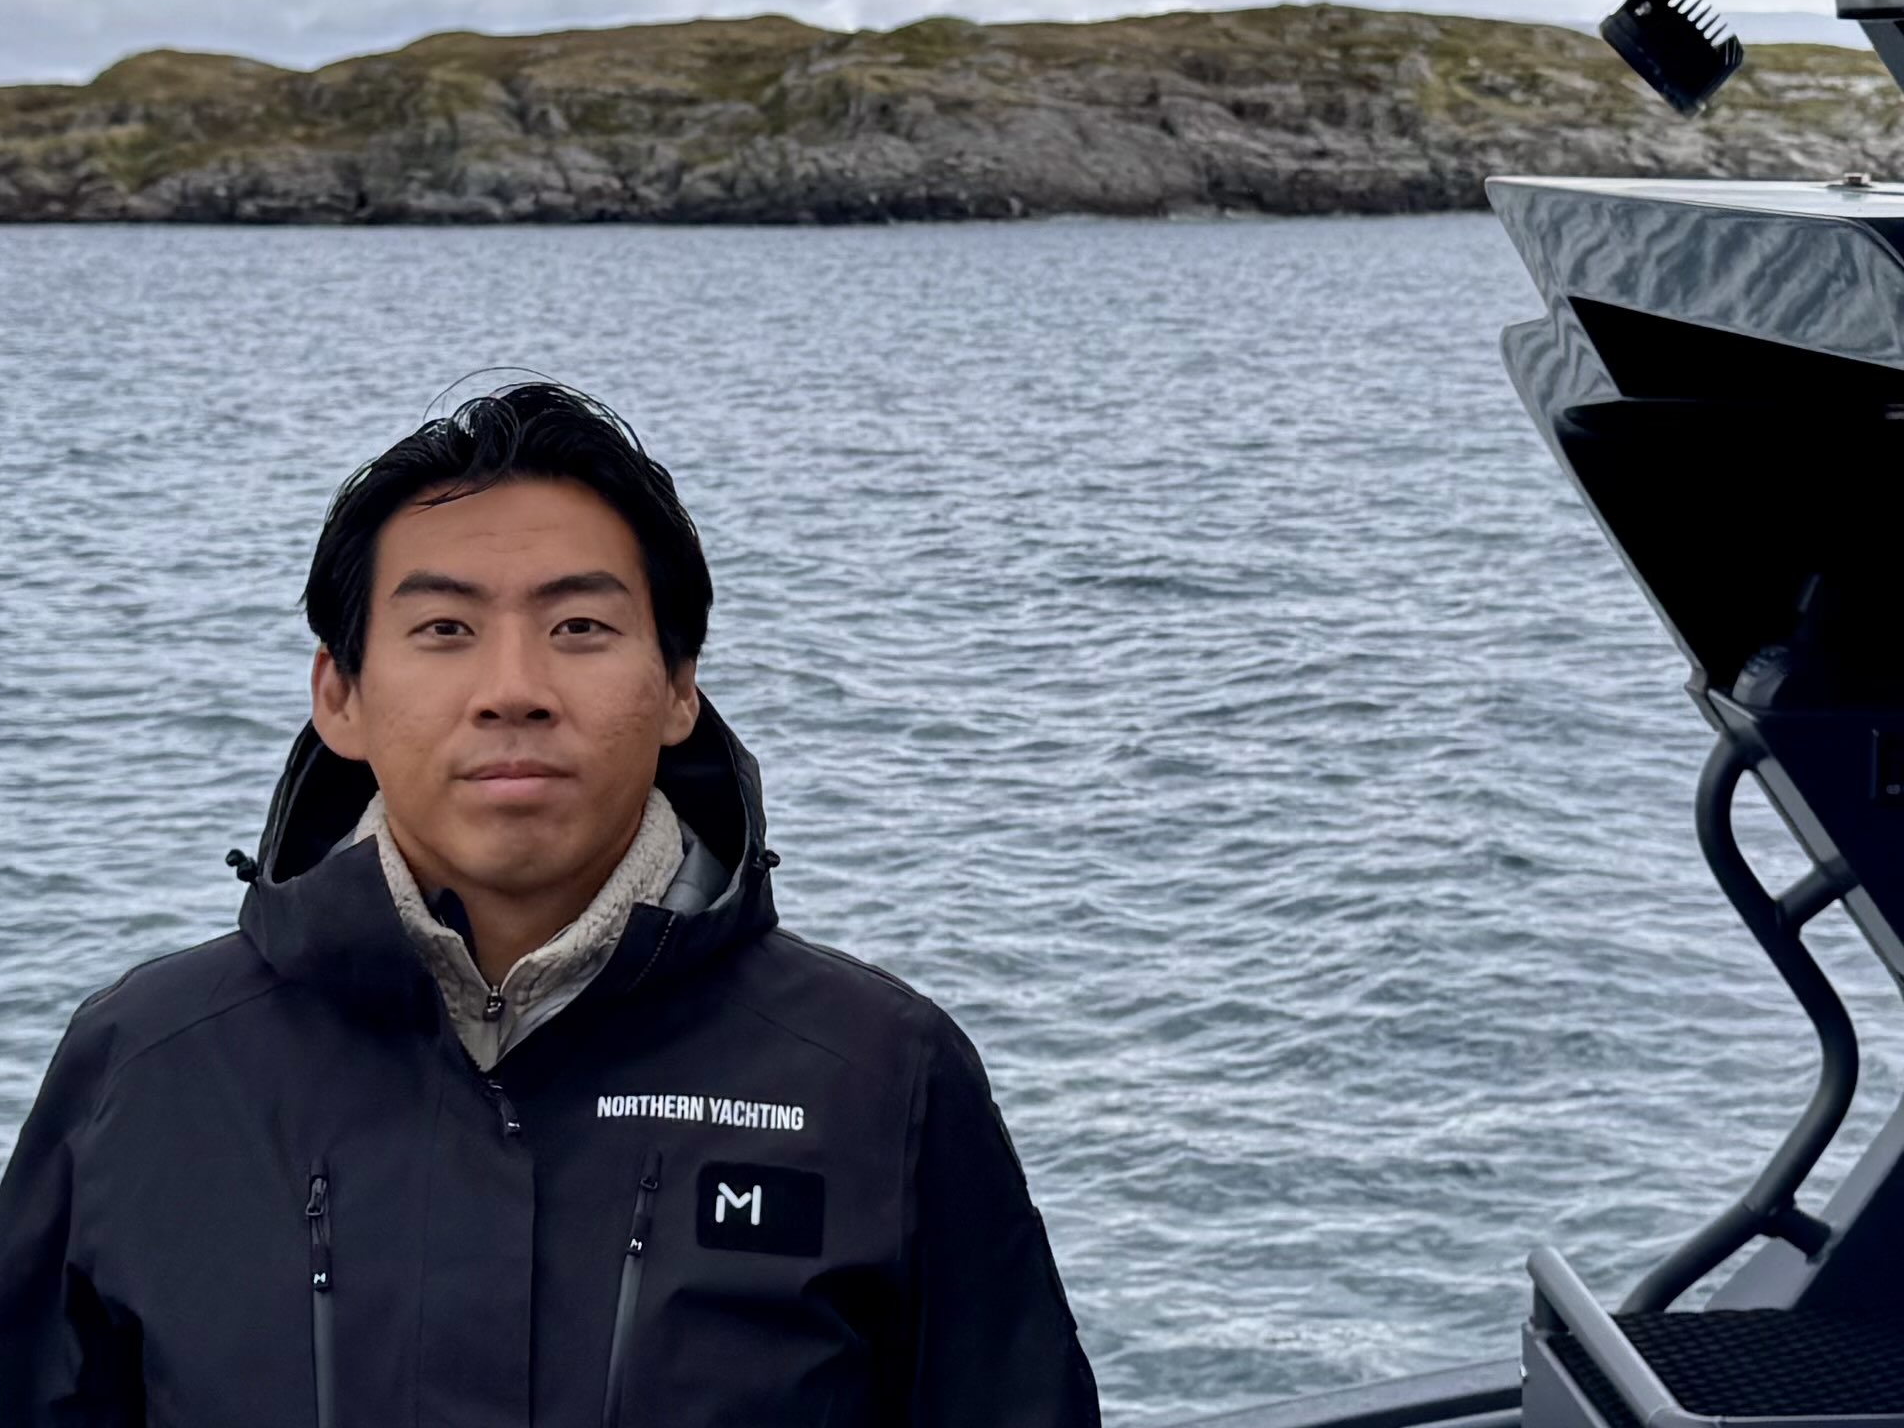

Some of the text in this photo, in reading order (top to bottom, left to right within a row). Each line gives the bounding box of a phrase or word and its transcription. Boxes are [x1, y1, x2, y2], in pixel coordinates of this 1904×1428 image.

[597, 1095, 805, 1131] NORTHERN YACHTING
[715, 1182, 762, 1226] M
